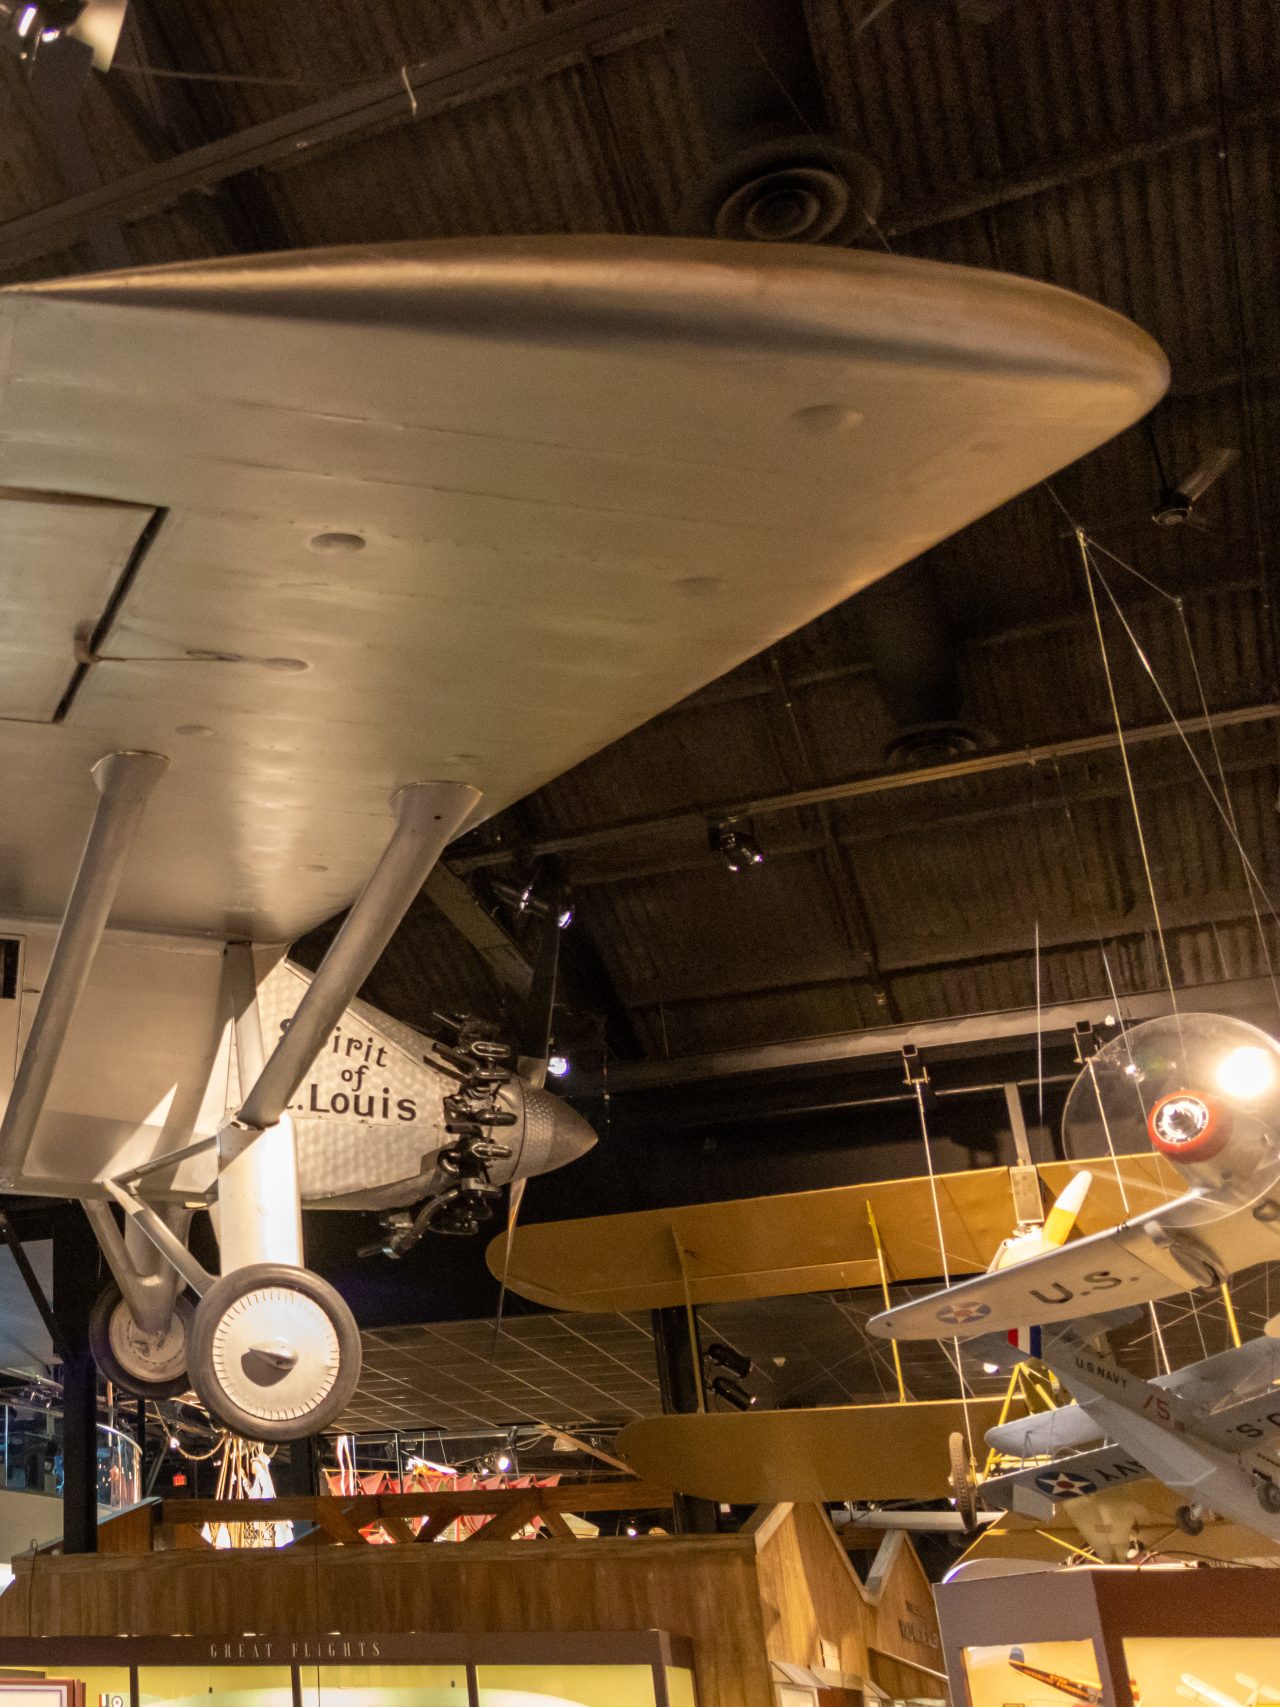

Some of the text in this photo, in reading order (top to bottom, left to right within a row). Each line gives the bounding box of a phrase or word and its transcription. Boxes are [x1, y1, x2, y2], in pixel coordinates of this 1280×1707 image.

[341, 1065, 370, 1092] of
[1029, 1270, 1140, 1304] U.S.
[210, 1641, 381, 1659] GREAT FLIGHTS
